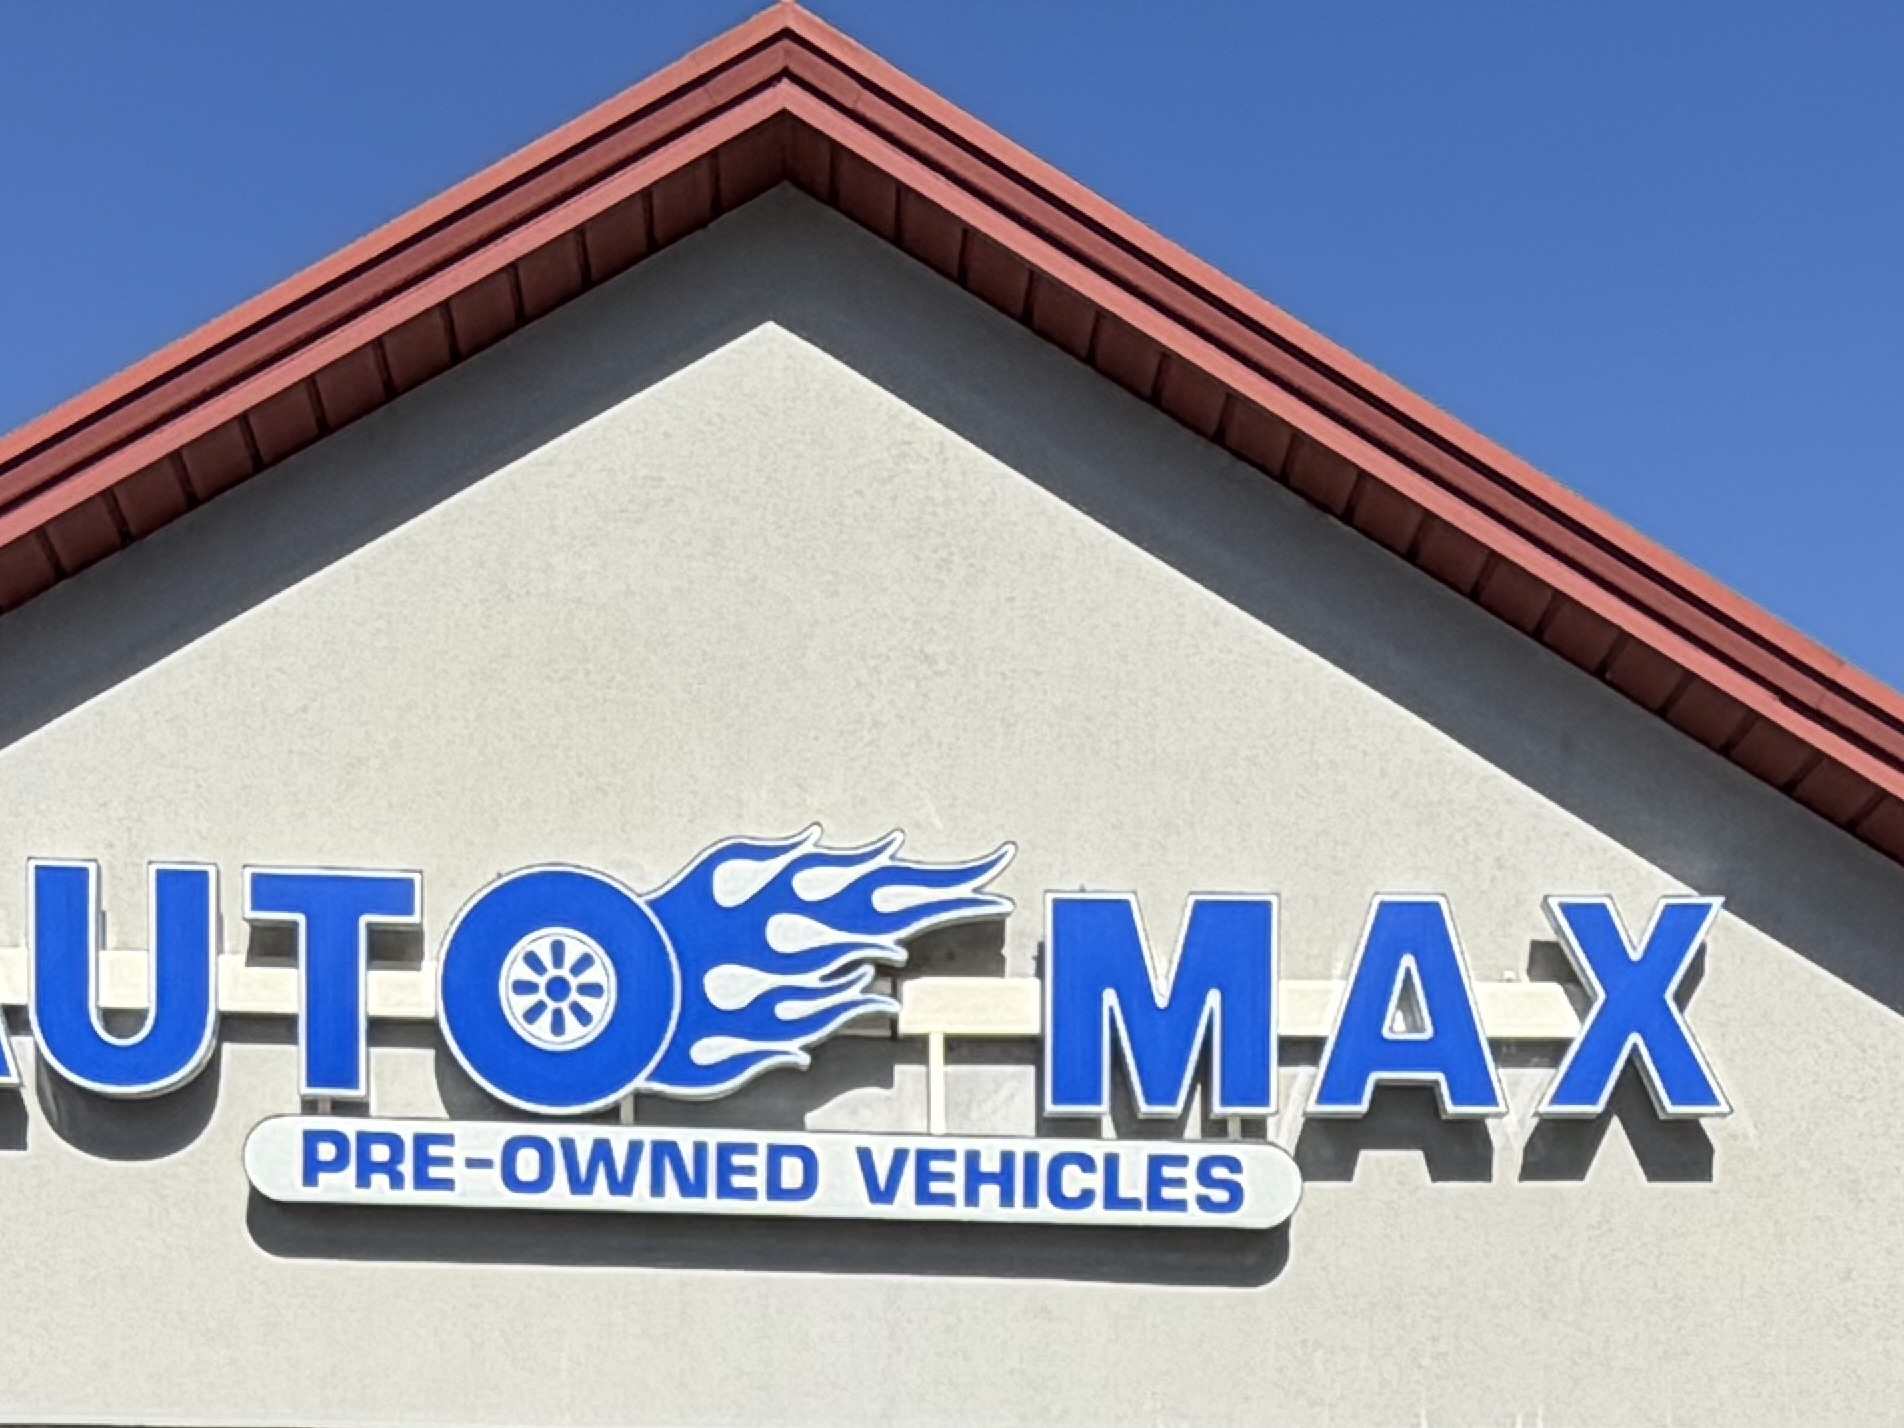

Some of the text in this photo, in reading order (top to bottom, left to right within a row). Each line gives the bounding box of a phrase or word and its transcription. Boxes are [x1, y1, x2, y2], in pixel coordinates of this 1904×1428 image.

[1043, 889, 1734, 1119] MAX
[301, 1128, 1244, 1214] PRE-OWNED VEHICLES
